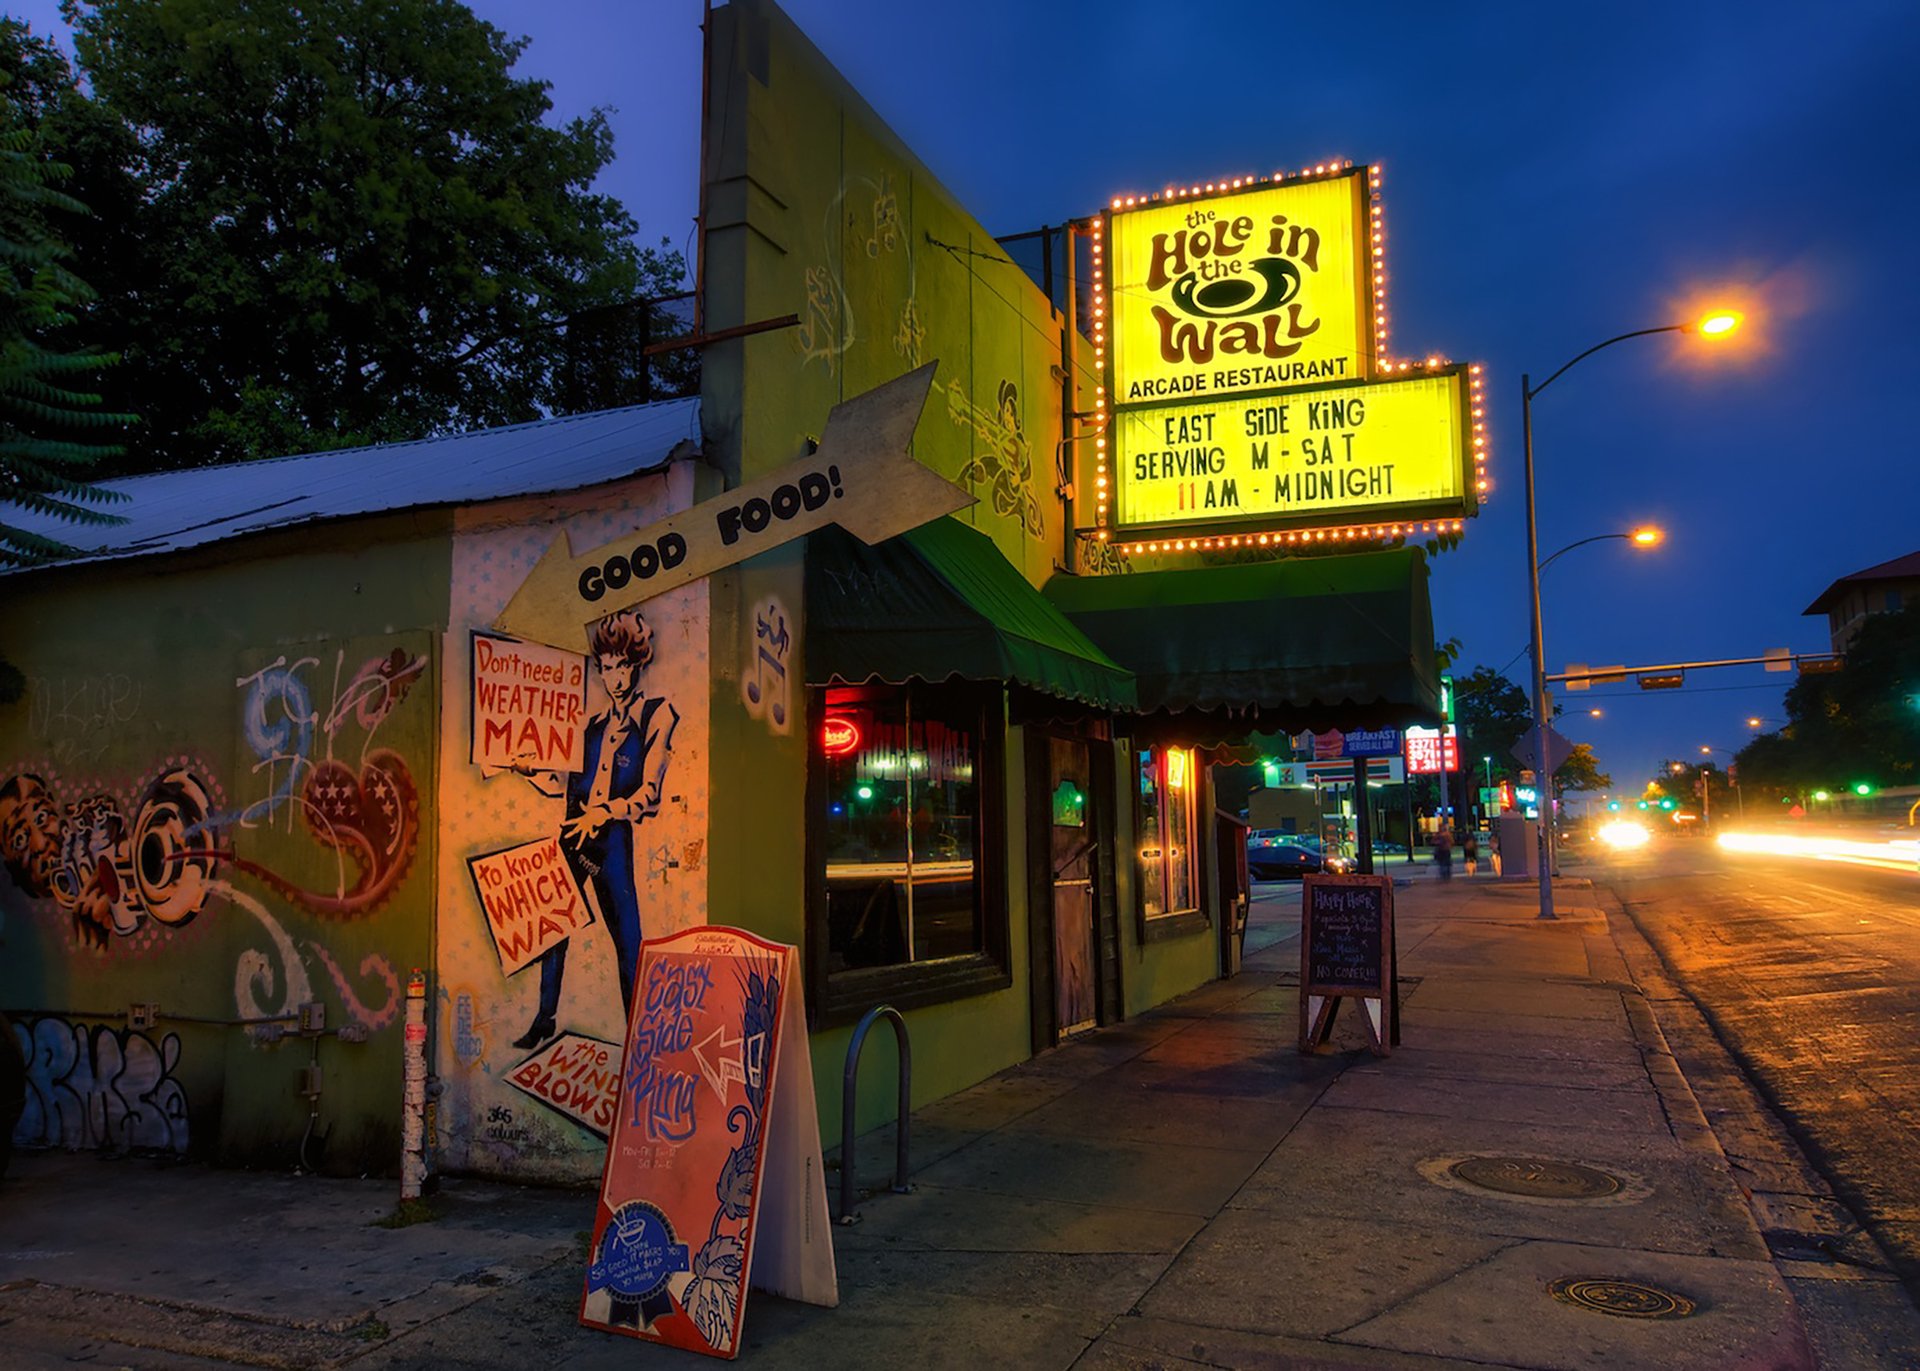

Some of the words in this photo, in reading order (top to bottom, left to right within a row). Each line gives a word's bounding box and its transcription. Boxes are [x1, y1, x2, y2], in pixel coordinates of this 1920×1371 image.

[1185, 210, 1216, 229] the
[1266, 214, 1321, 272] in
[1197, 259, 1243, 281] the
[1129, 373, 1207, 398] ARCADE
[1213, 357, 1349, 389] RESTAURANT
[1165, 413, 1217, 445] EAST
[1135, 447, 1226, 481] SERVING
[1251, 441, 1269, 470] M
[1275, 464, 1395, 503] MIDNIGHT
[578, 532, 687, 601] GOOD
[716, 464, 844, 546] FOOD!
[476, 639, 521, 676] Don't
[523, 659, 564, 684] need
[570, 664, 582, 687] a
[477, 676, 583, 726] WEATHER-
[485, 717, 574, 762] MAN
[1345, 729, 1396, 742] BREAKFAST
[479, 864, 503, 889] to
[503, 838, 558, 879] know
[485, 867, 572, 929] WHICH
[498, 894, 577, 962] WAY
[645, 957, 714, 1012] East
[572, 1042, 608, 1066] the
[636, 1009, 694, 1057] Side
[513, 1062, 617, 1126] BLOWS
[628, 1060, 700, 1142] King
